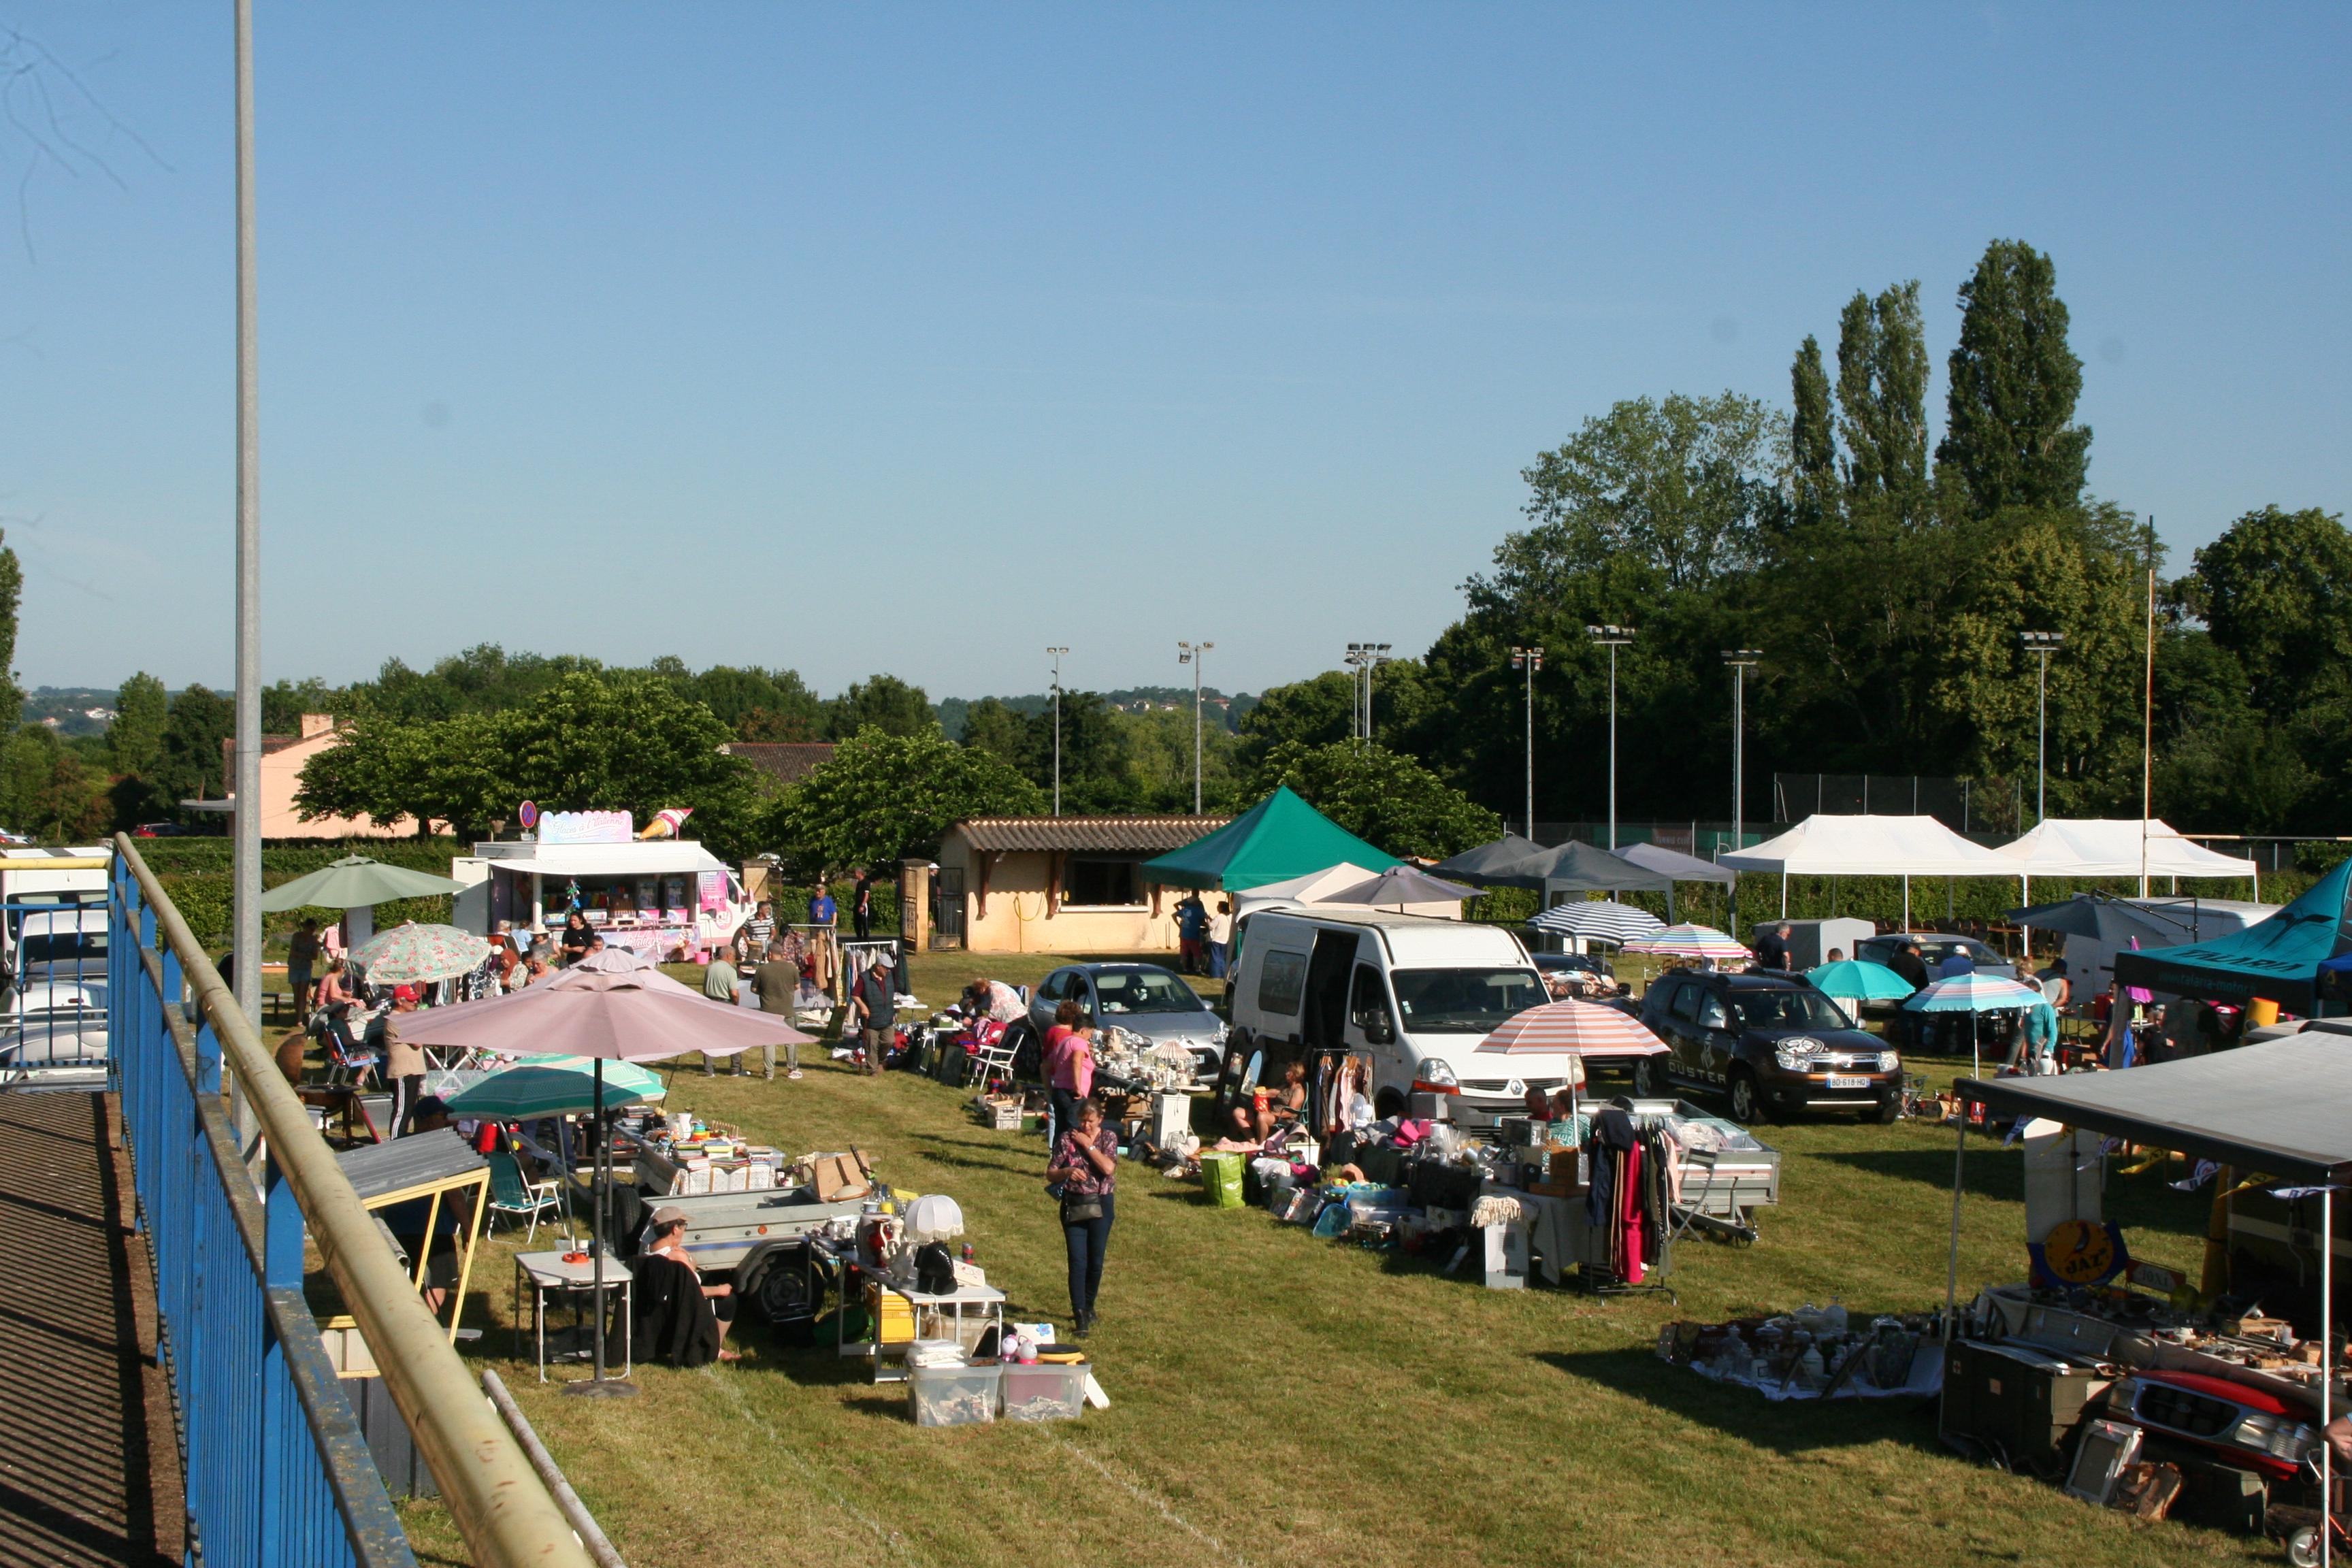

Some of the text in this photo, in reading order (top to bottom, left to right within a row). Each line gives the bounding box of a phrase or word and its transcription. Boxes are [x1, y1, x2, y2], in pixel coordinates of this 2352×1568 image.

[551, 820, 576, 835] Glaces
[2173, 949, 2306, 972] TALARIA
[2159, 971, 2257, 996] www.talaria-motor.fr
[1668, 1062, 1727, 1085] DUSTER
[2066, 1254, 2104, 1275] JAZ
